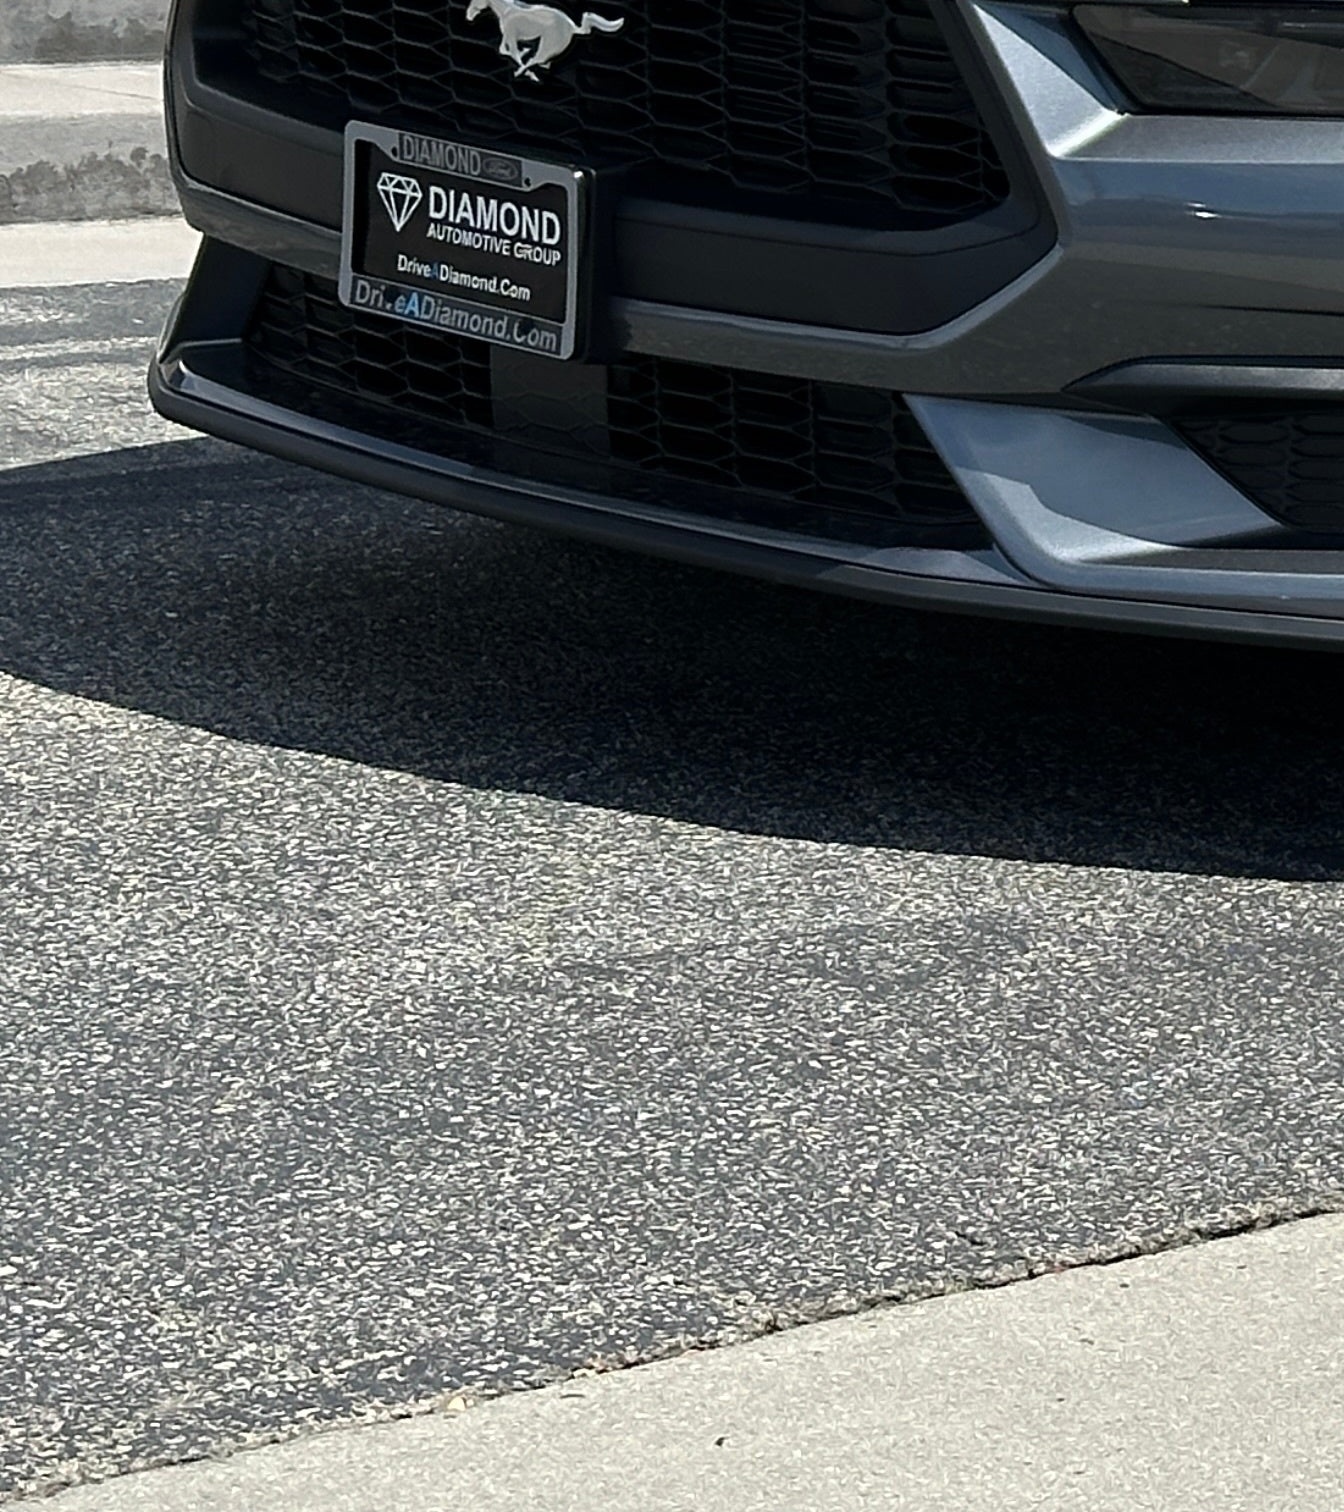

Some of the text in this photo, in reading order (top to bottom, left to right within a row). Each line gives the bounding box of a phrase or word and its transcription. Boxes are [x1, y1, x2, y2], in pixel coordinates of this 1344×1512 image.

[403, 135, 480, 176] DIAMOND
[429, 185, 561, 245] DIAMOND
[426, 222, 561, 267] AUTOMOTIVE GROUP
[397, 253, 531, 301] DriveADiamond.Com
[354, 279, 558, 352] DrieADiamond.Com
